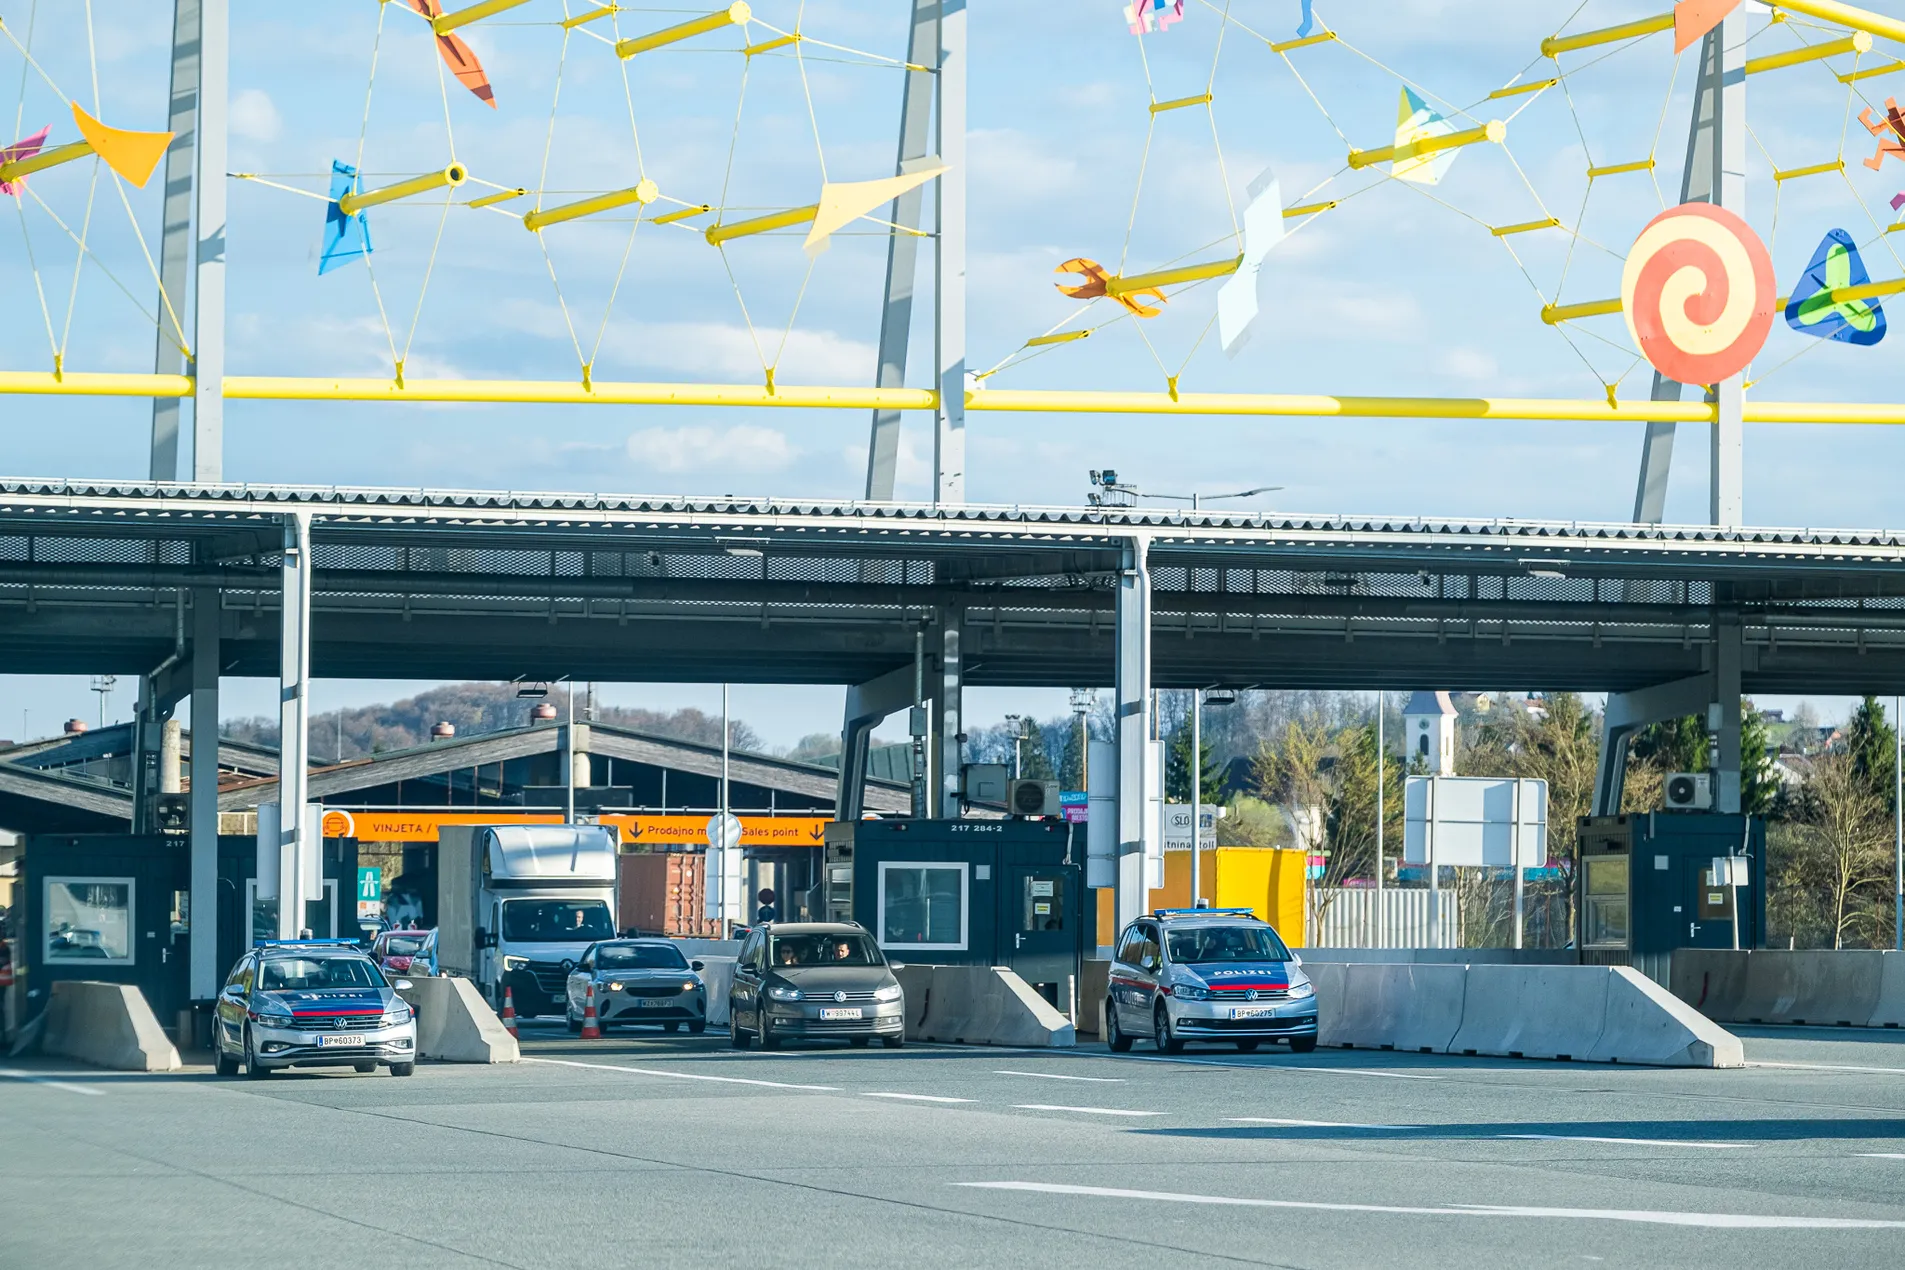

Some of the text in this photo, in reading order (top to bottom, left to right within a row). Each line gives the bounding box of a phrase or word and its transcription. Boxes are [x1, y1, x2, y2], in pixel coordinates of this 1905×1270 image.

[1174, 815, 1190, 826] SLO
[373, 823, 423, 833] VINJETA
[648, 825, 694, 837] Prodajno
[742, 827, 799, 838] Sales point
[951, 824, 1003, 832] 217 284-2
[1164, 840, 1191, 849] tnina
